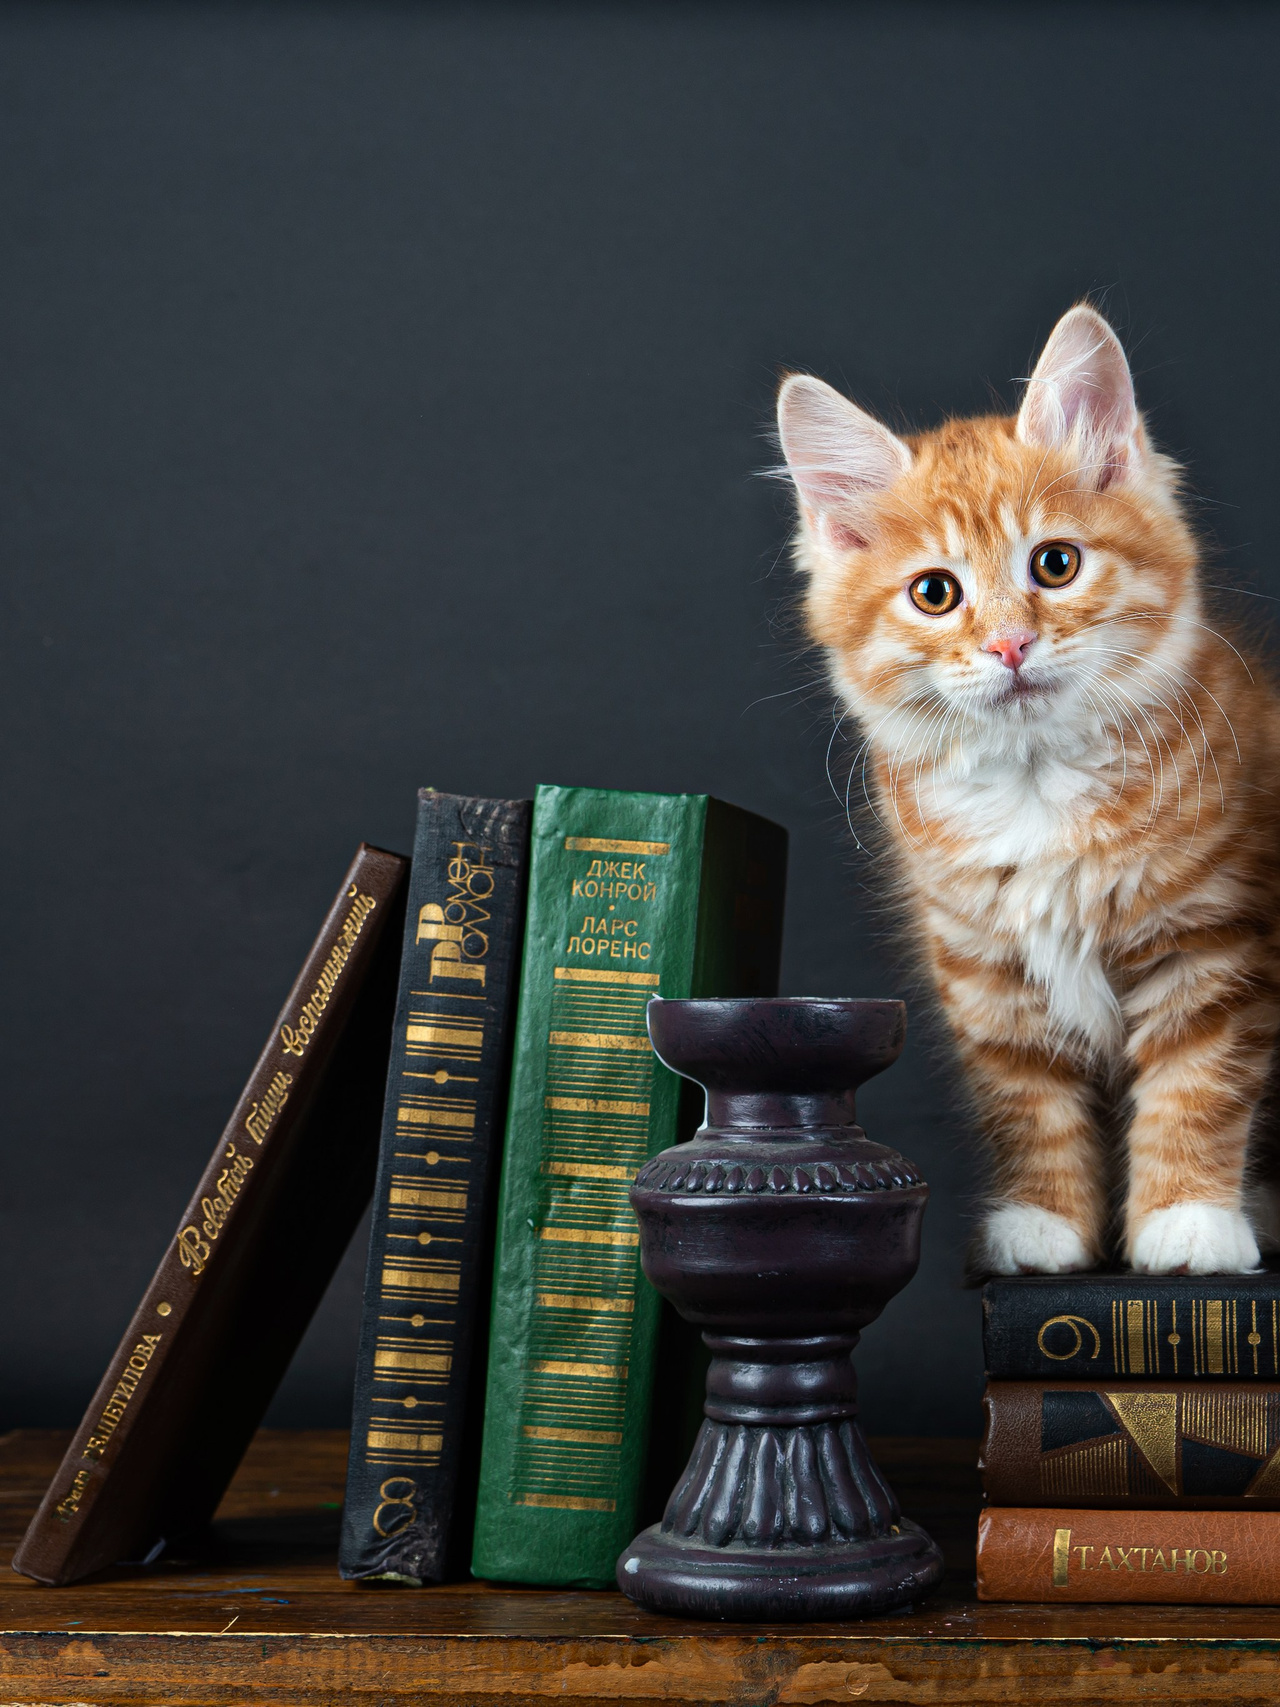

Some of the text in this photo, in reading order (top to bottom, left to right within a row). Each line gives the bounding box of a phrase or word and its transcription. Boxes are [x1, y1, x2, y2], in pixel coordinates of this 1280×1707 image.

[586, 859, 645, 880] ДЖЕК
[571, 879, 657, 902] КОНРОЙ
[580, 916, 639, 937] ЛАРС
[566, 936, 652, 960] ЛОРЕНС
[178, 883, 377, 1276] В святой тиши воспоминаний
[372, 1476, 418, 1538] 8
